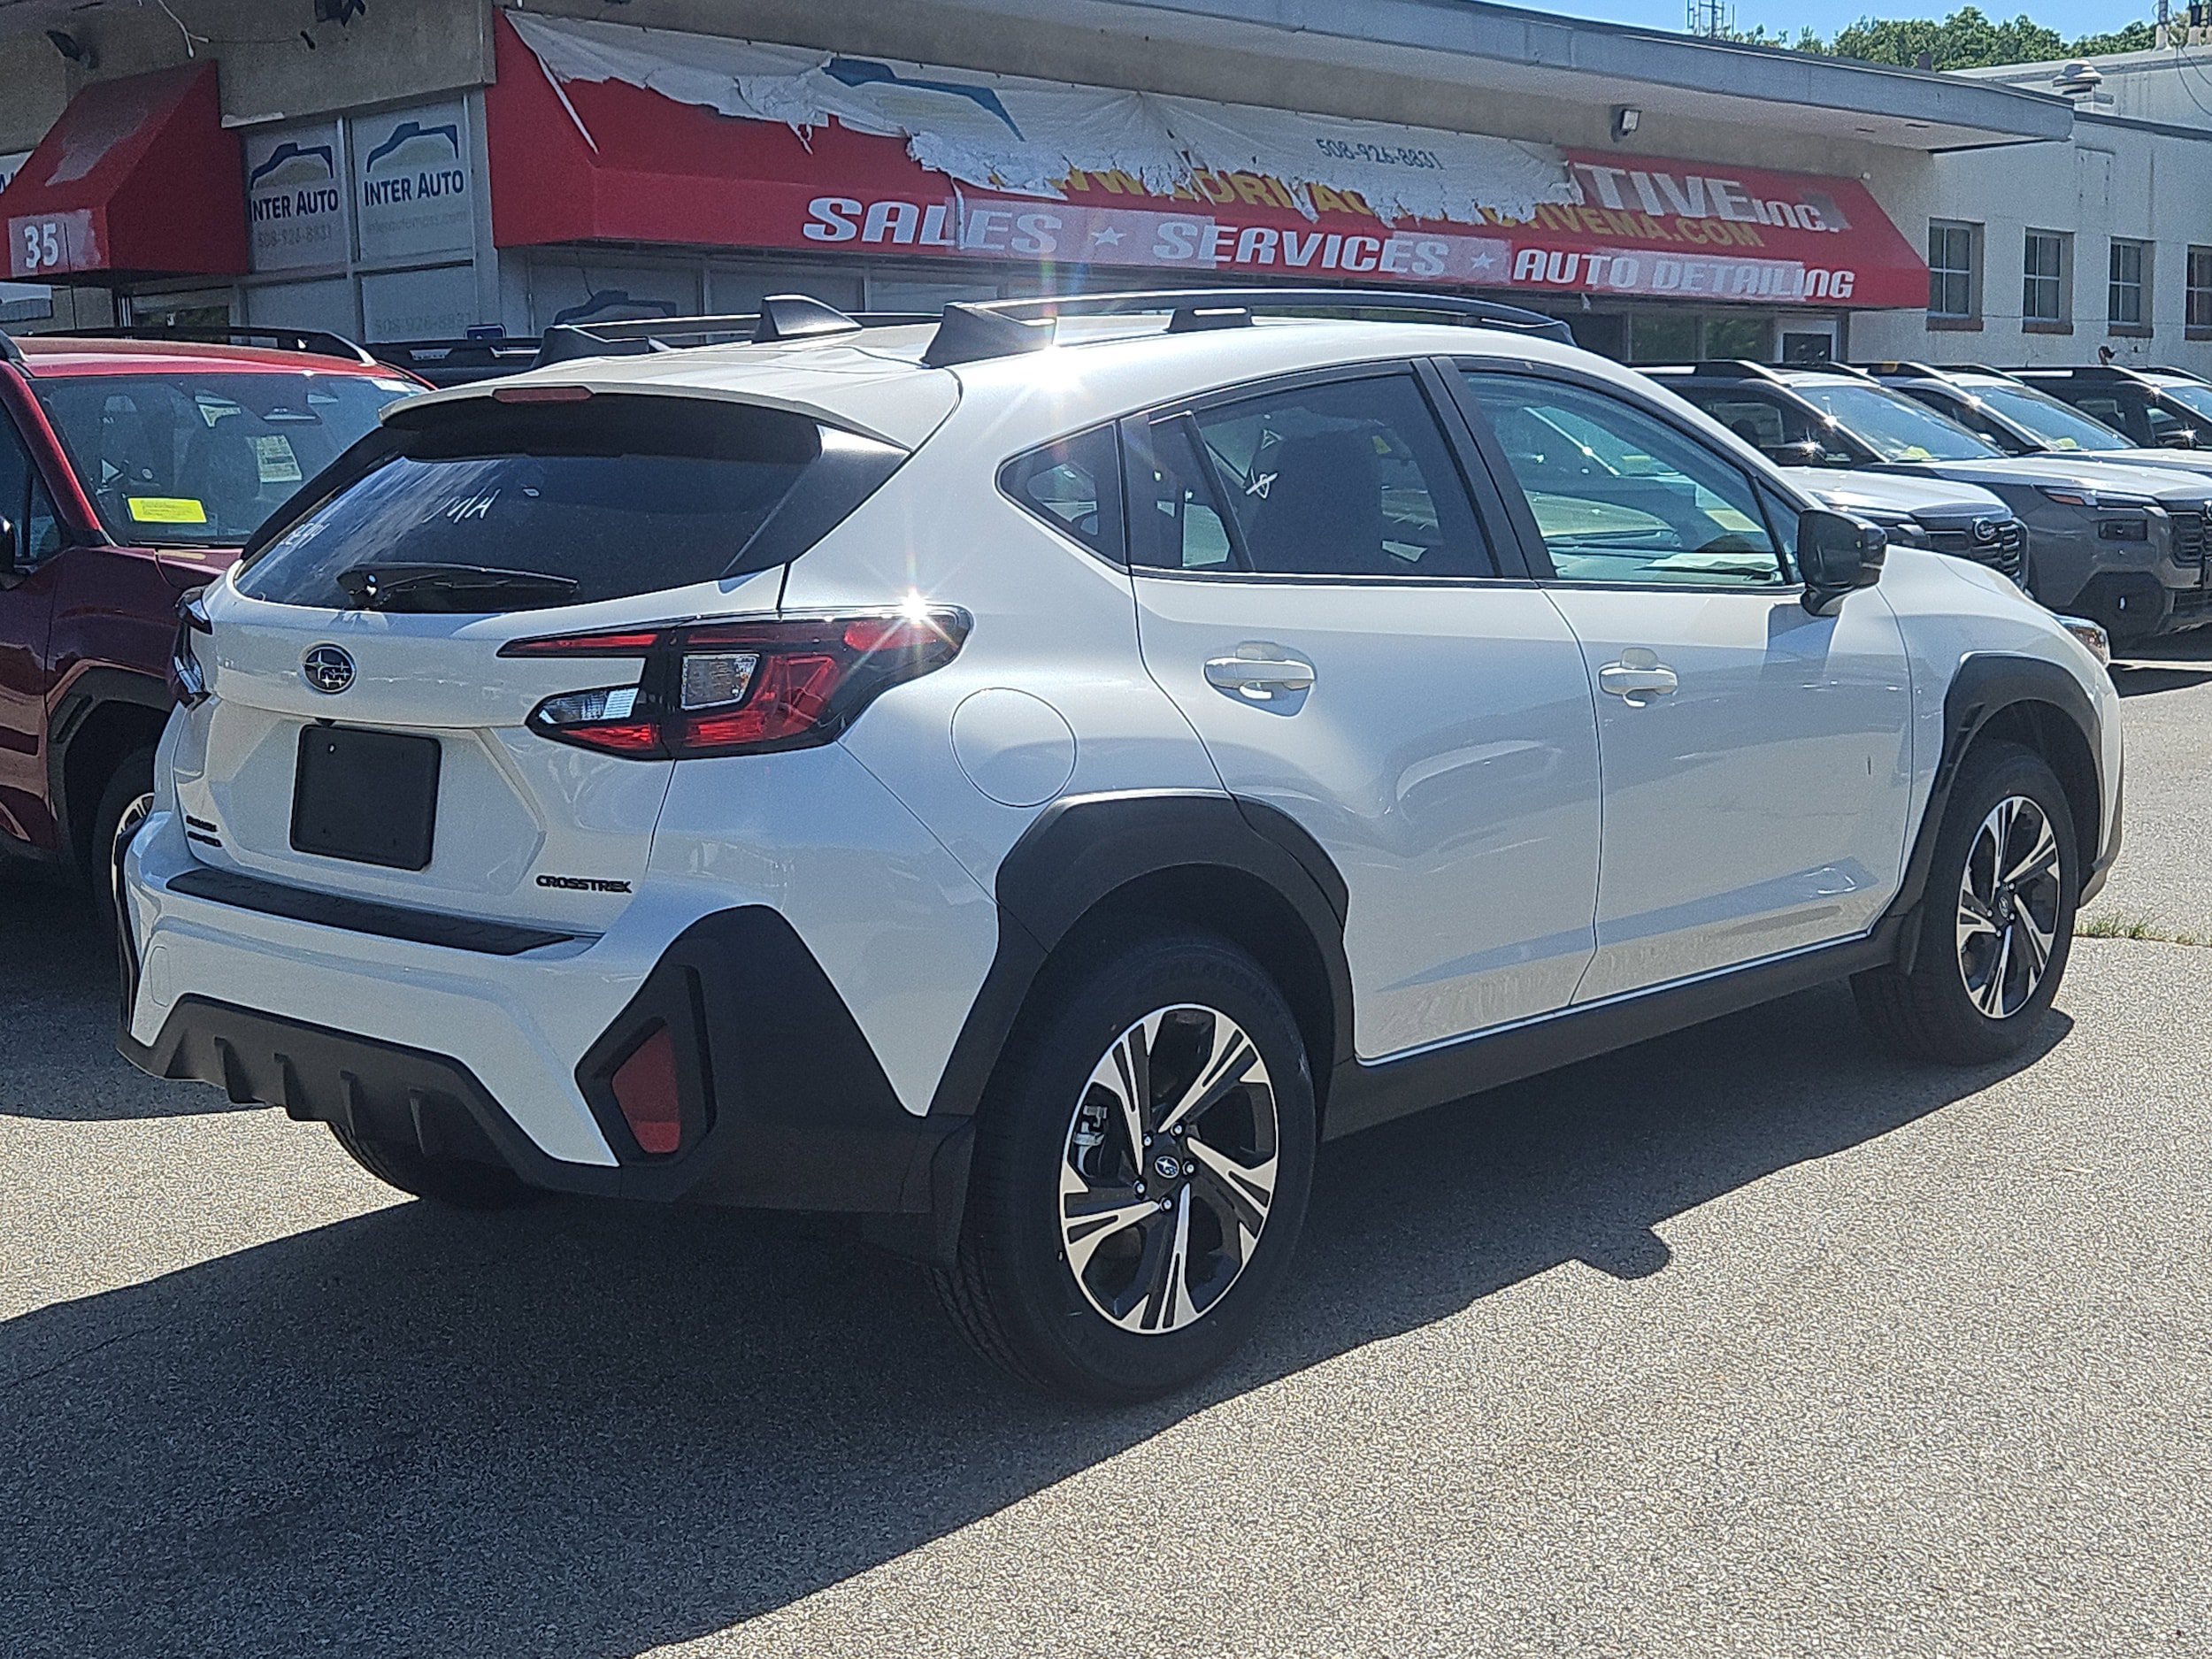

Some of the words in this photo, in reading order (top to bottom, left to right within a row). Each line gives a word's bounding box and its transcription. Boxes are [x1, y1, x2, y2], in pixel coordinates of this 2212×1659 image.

[1316, 137, 1445, 170] 508-926-8831
[249, 194, 292, 223] INTER
[296, 188, 340, 217] AUTO
[364, 177, 412, 206] INTER
[417, 170, 465, 199] AUTO
[24, 222, 59, 269] 35
[803, 196, 1063, 254] SALES
[1152, 220, 1450, 276] SERVICES
[1512, 248, 1640, 288] AUTO
[1652, 259, 1855, 299] DETAILING
[535, 874, 633, 894] CROSSTREK
